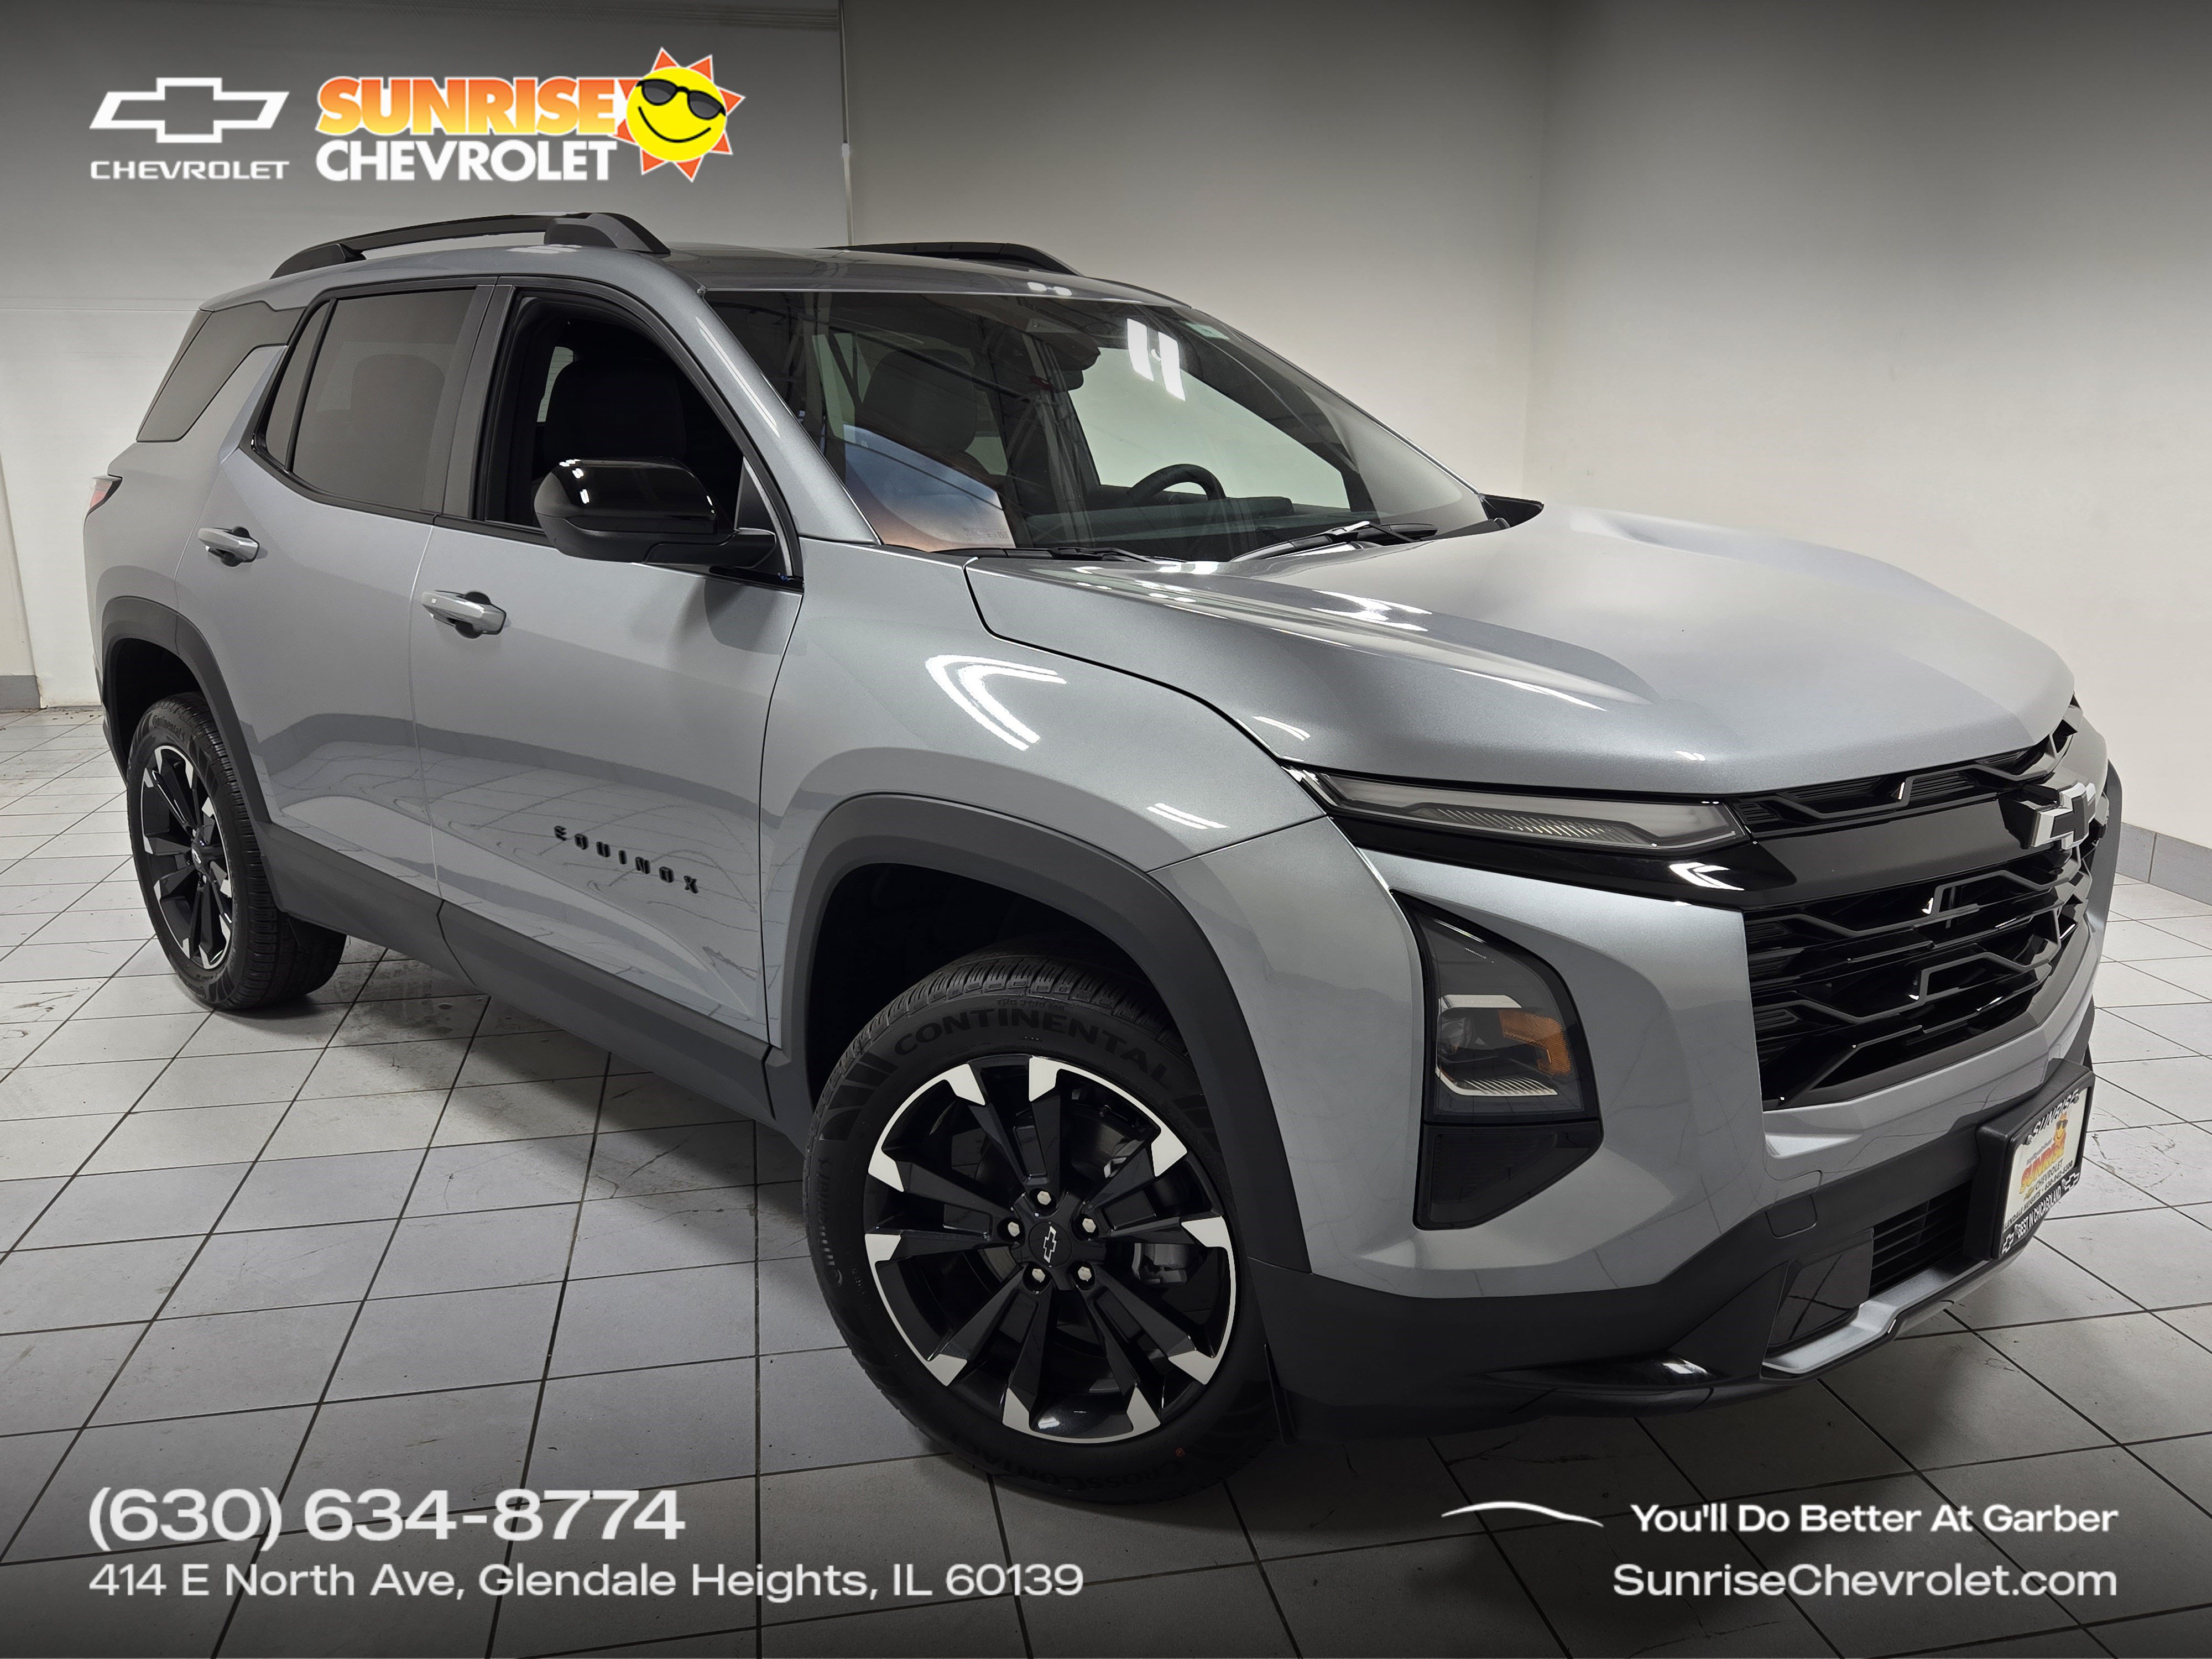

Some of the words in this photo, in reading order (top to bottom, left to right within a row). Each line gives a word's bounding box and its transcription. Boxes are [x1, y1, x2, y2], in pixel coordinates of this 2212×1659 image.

[554, 825, 699, 894] EQUINOX
[894, 1007, 1173, 1089] CONTINENTAL
[2033, 1088, 2079, 1137] SUNRISE
[2035, 1159, 2064, 1191] CHEVROLET
[2003, 1206, 2023, 1229] LENDALE
[2017, 1215, 2029, 1239] BEST
[2033, 1185, 2062, 1223] CHICAGOLAND
